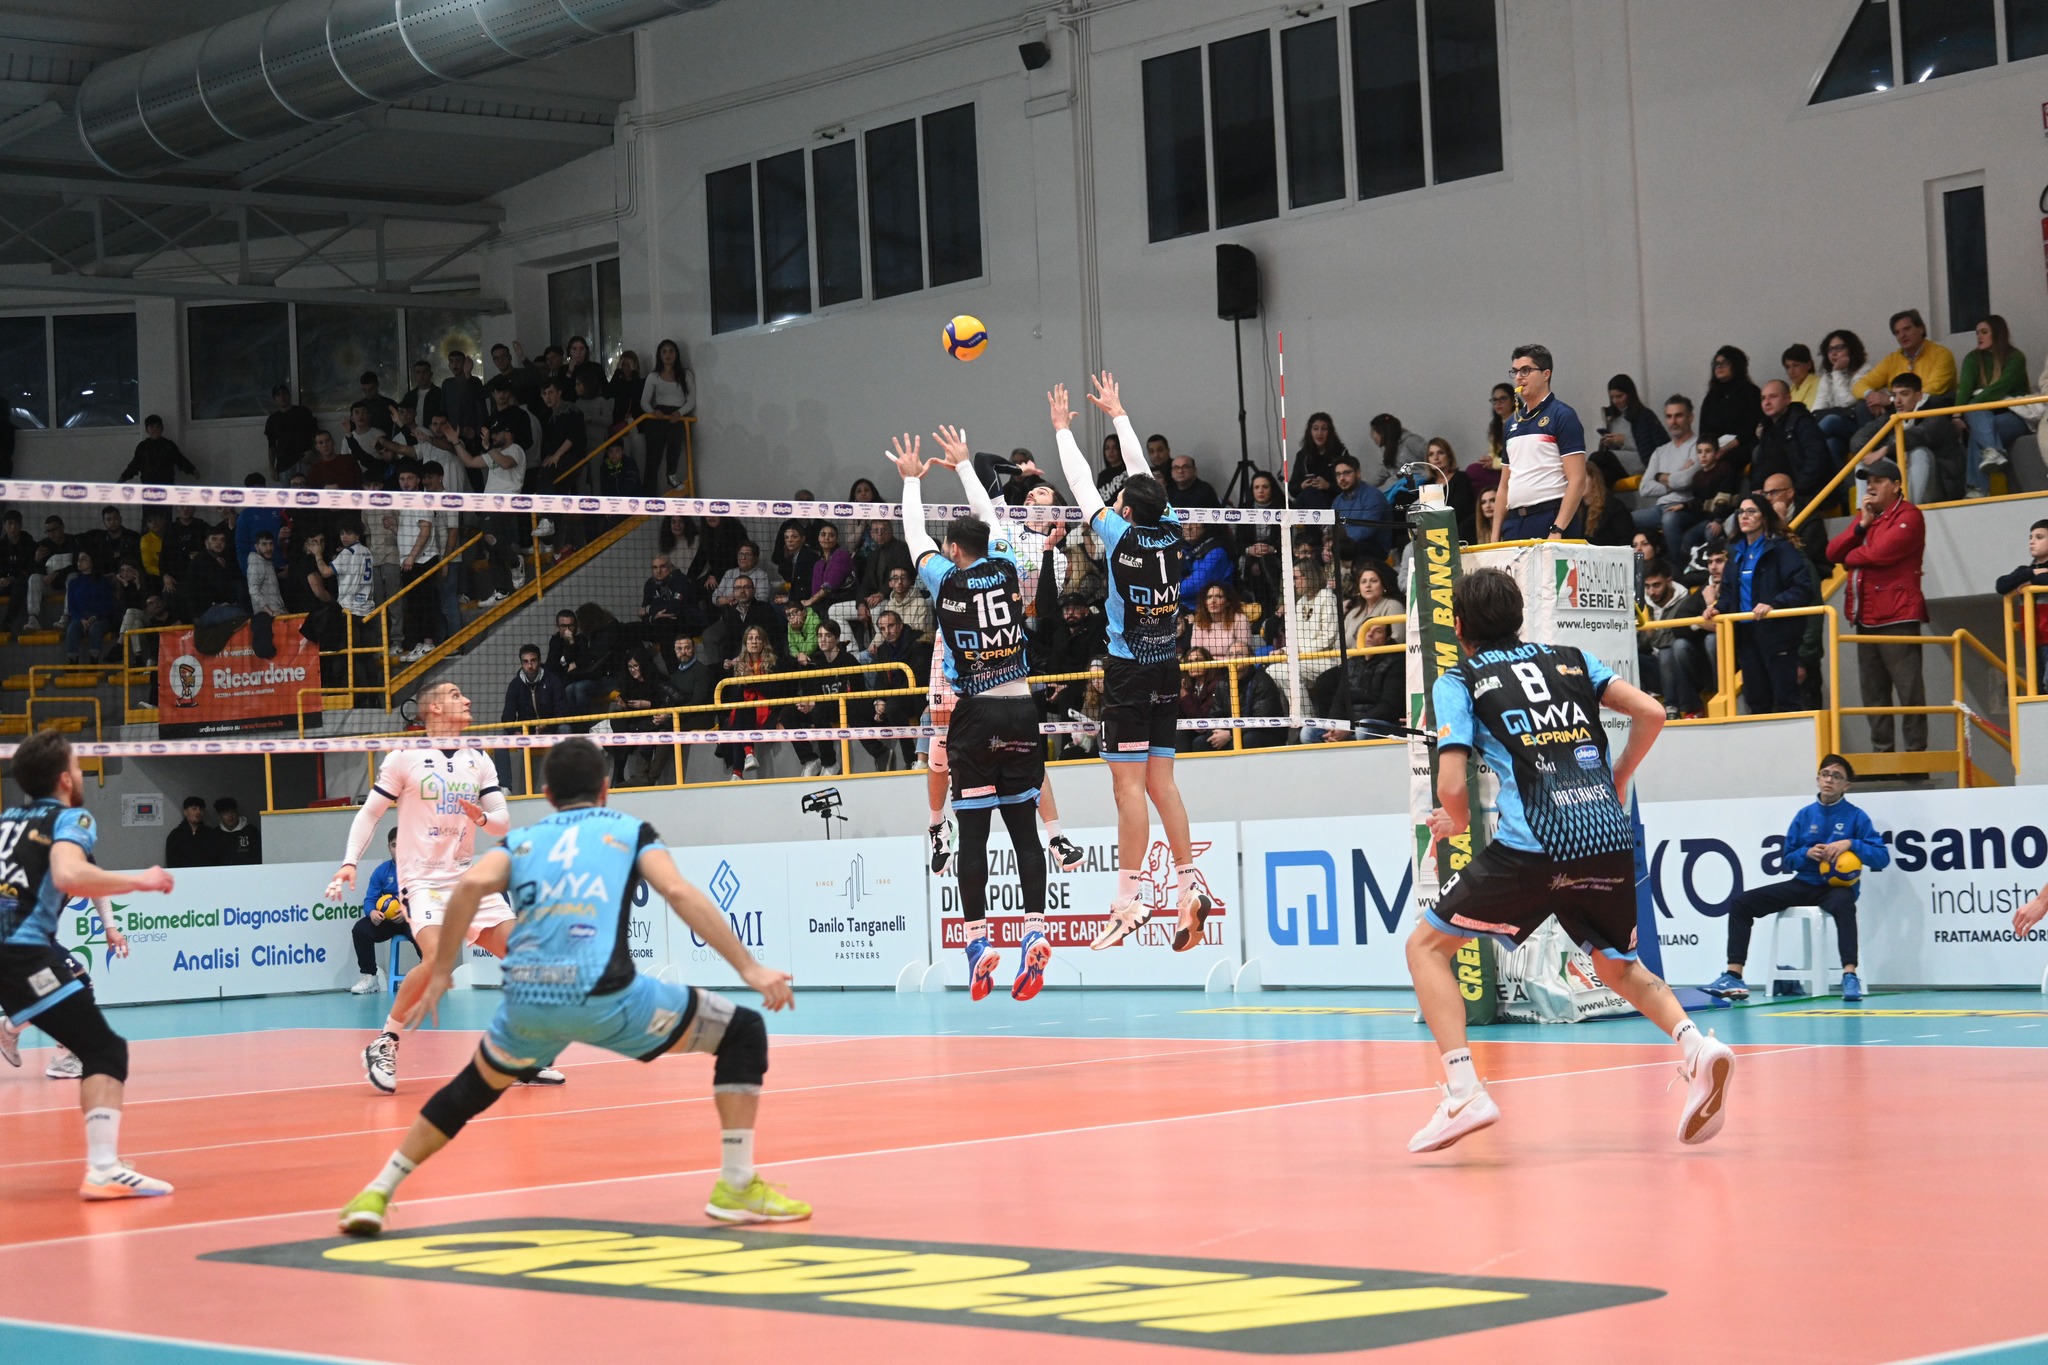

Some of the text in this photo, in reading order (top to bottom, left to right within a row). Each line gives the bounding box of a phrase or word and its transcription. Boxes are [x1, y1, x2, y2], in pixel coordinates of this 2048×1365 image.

[364, 558, 372, 581] 5
[1156, 550, 1167, 584] 1
[1426, 527, 1454, 627] BANCA
[973, 588, 1011, 628] 16
[1579, 594, 1626, 608] SERIE A
[1557, 618, 1628, 632] www.legavolley.it
[213, 663, 306, 689] Riccardone
[1510, 661, 1551, 703] 8
[933, 694, 942, 704] 13
[1530, 701, 1590, 731] MYA
[1521, 727, 1592, 747] EXPRIMA
[1577, 748, 1598, 759] chicco
[447, 762, 453, 773] 5
[548, 825, 580, 869] 4
[540, 872, 609, 904] MYA
[941, 886, 959, 911] DI
[127, 909, 220, 931] Biomedical
[223, 903, 310, 930] Diagnostic
[312, 902, 364, 921] Center
[426, 911, 432, 919] 5
[809, 915, 906, 936] Danilo Tanganelli
[122, 931, 168, 944] arcianise
[840, 940, 874, 948] BOLTS &
[65, 958, 75, 969] 2
[173, 943, 326, 972] Analisi Cliniche
[835, 952, 880, 960] FASTENERS
